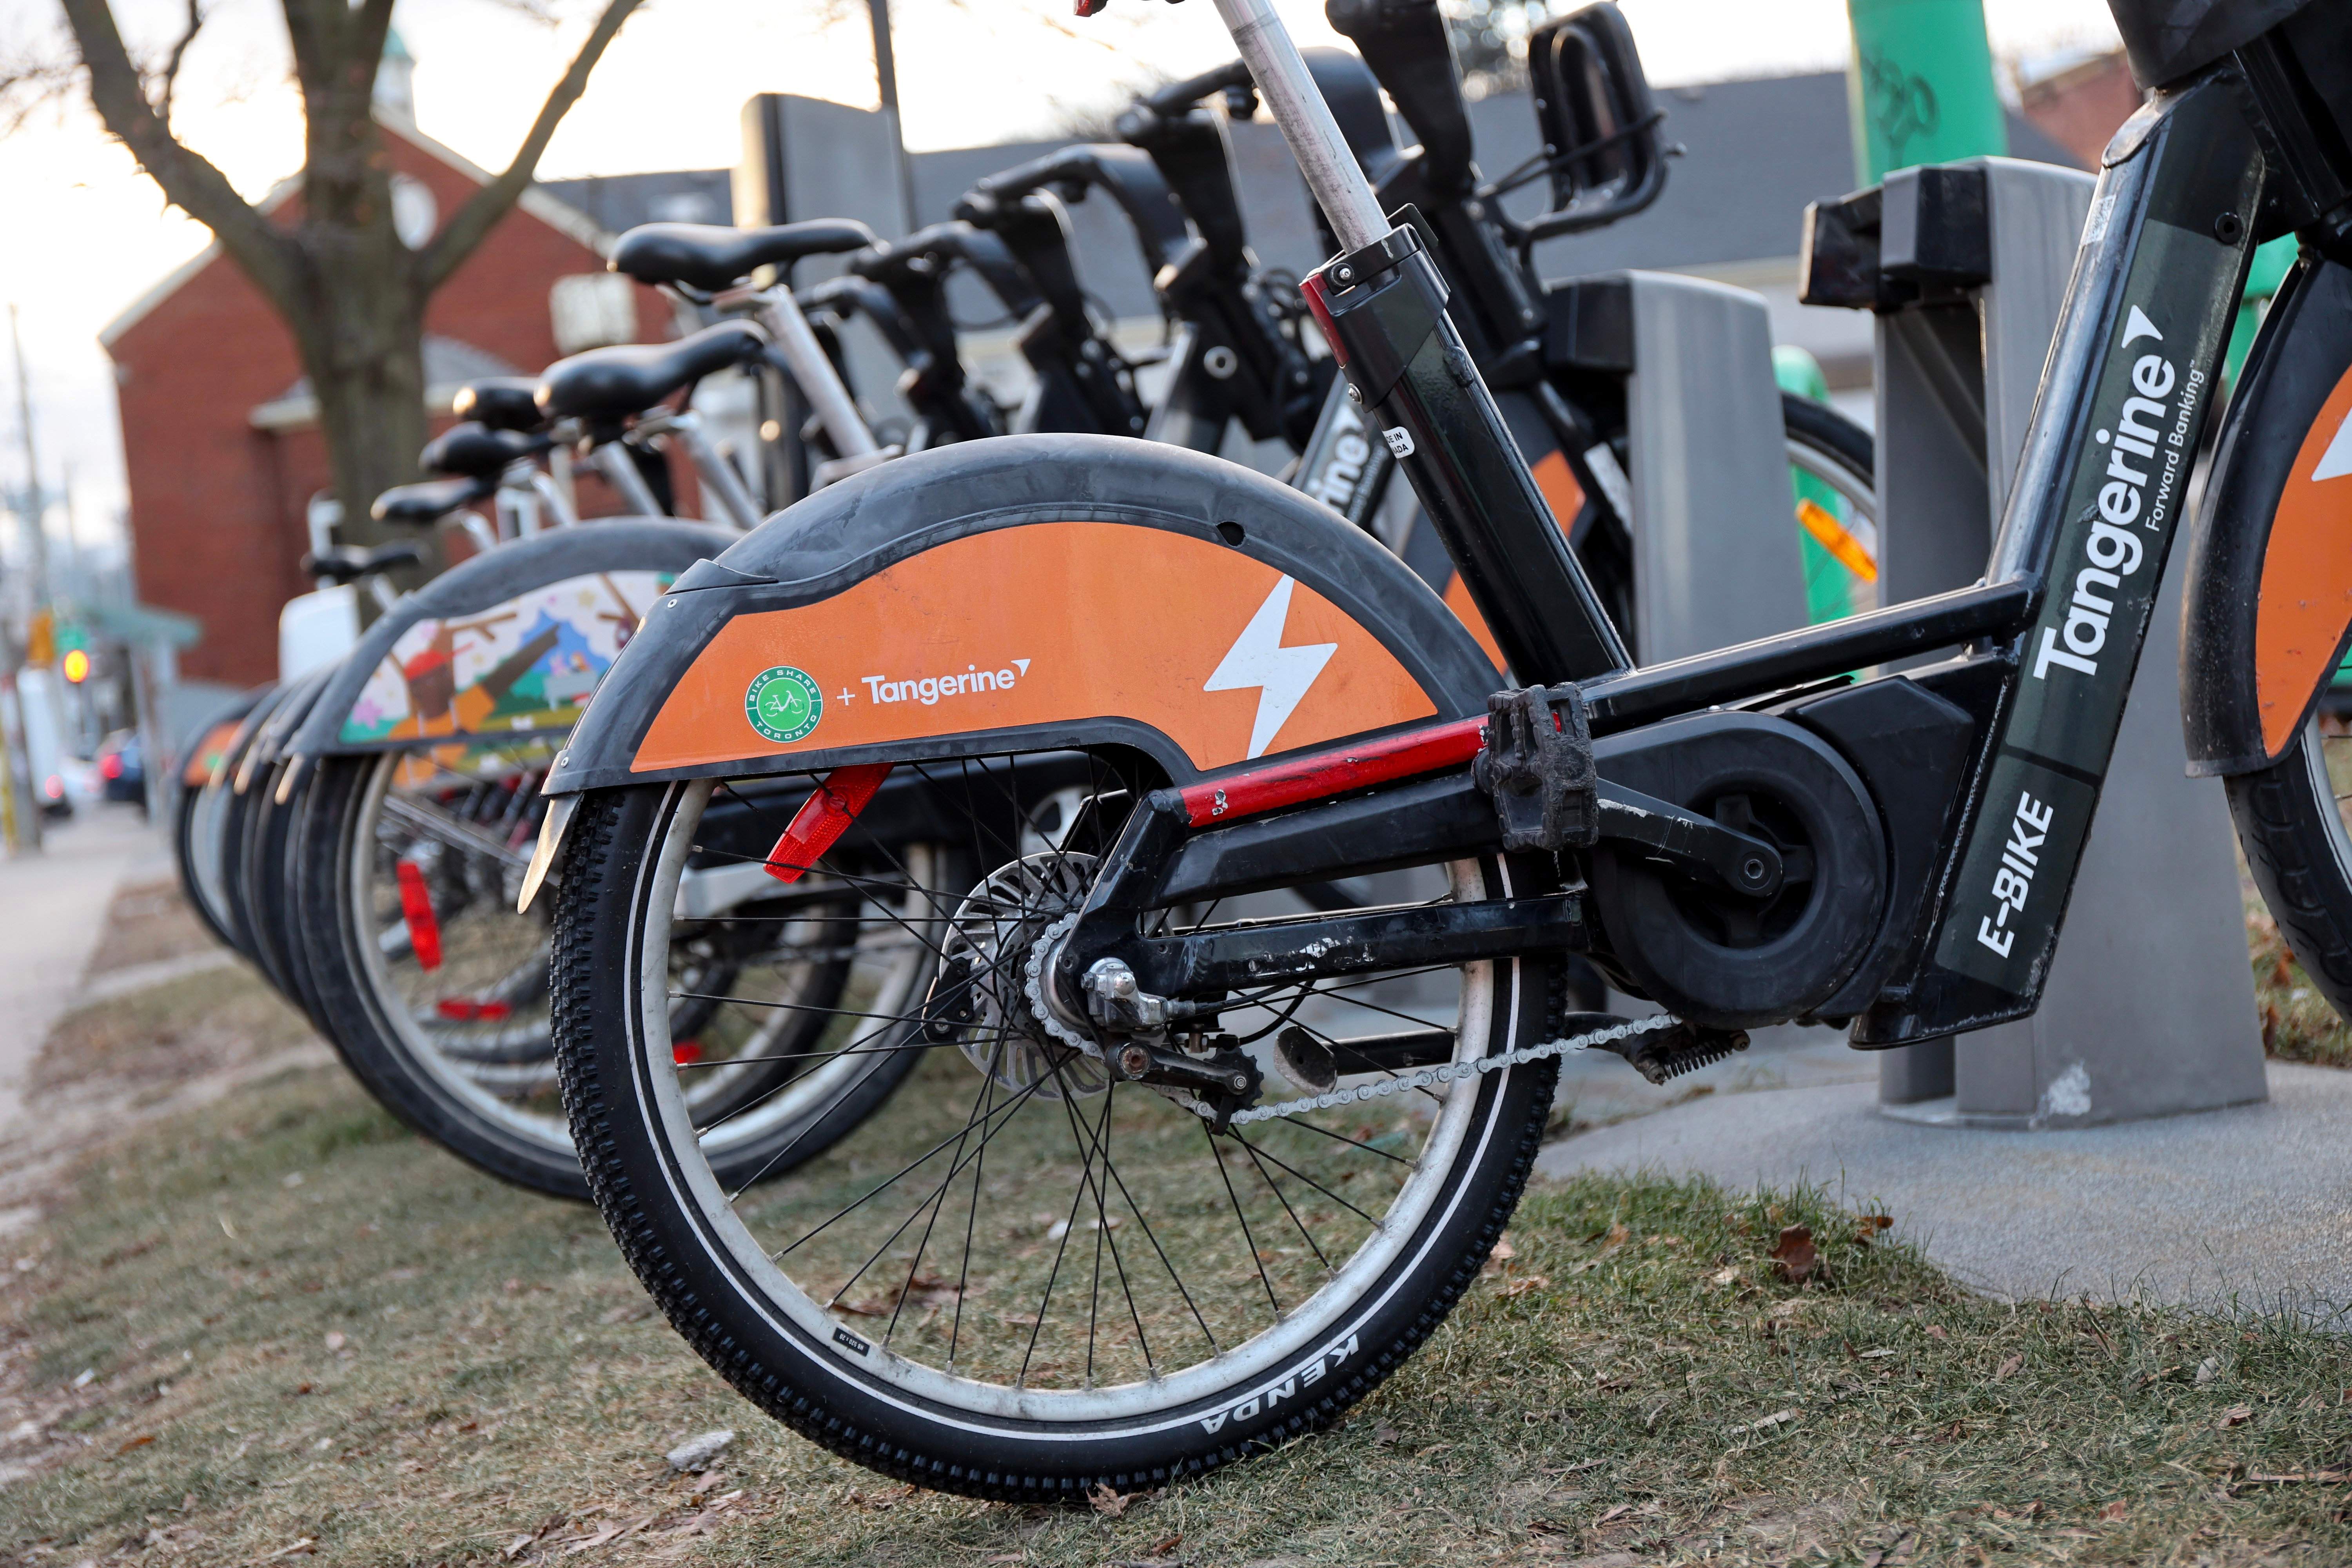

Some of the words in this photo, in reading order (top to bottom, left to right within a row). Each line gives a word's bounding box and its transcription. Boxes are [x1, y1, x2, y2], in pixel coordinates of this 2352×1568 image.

[1394, 432, 1403, 441] IN
[2145, 449, 2180, 532] Forward
[2033, 354, 2175, 680] Tangerine
[749, 675, 769, 701] BIKE
[777, 670, 816, 694] SHARE
[861, 664, 1015, 705] Tangerine
[757, 715, 817, 739] TORONTO
[1977, 790, 2053, 958] E-BIKE
[849, 1339, 857, 1347] 520
[1200, 1334, 1359, 1435] KENDA
